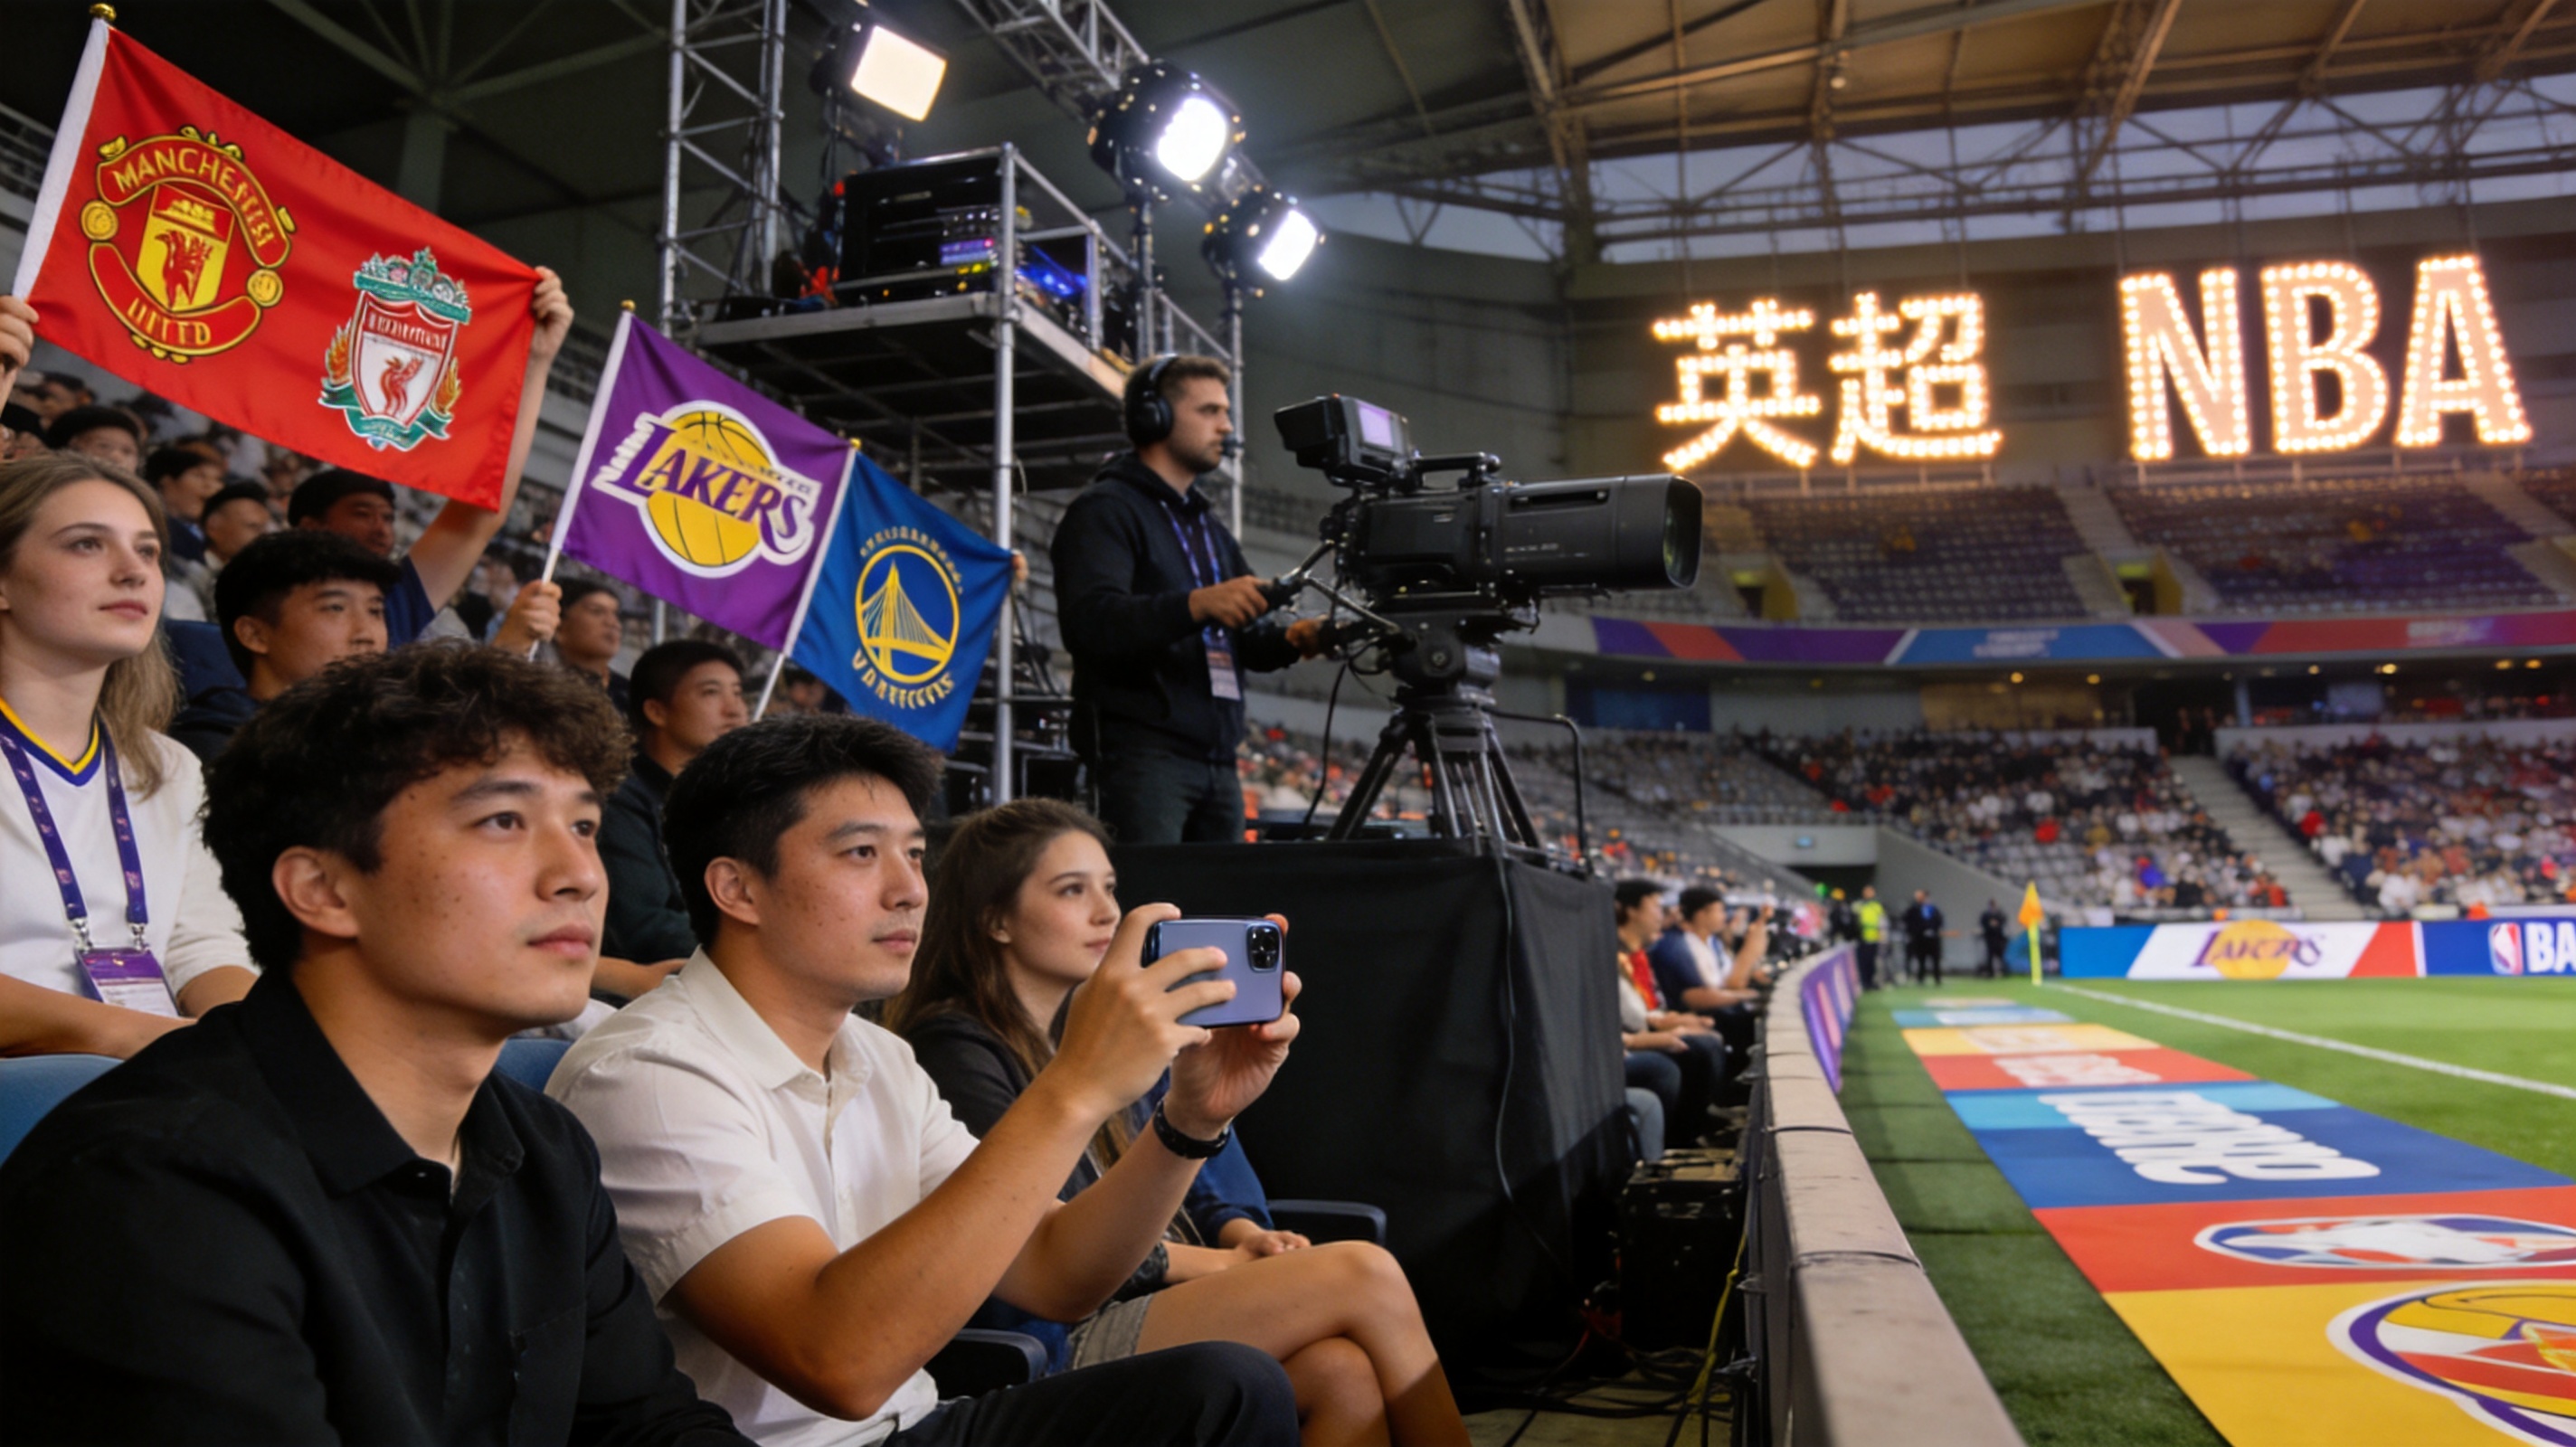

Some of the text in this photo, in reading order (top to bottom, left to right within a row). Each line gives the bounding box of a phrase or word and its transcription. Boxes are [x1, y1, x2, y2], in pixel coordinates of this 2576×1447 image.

[1652, 291, 2004, 472] 英超
[2117, 253, 2533, 460] NBA
[604, 421, 809, 555] LAKERS
